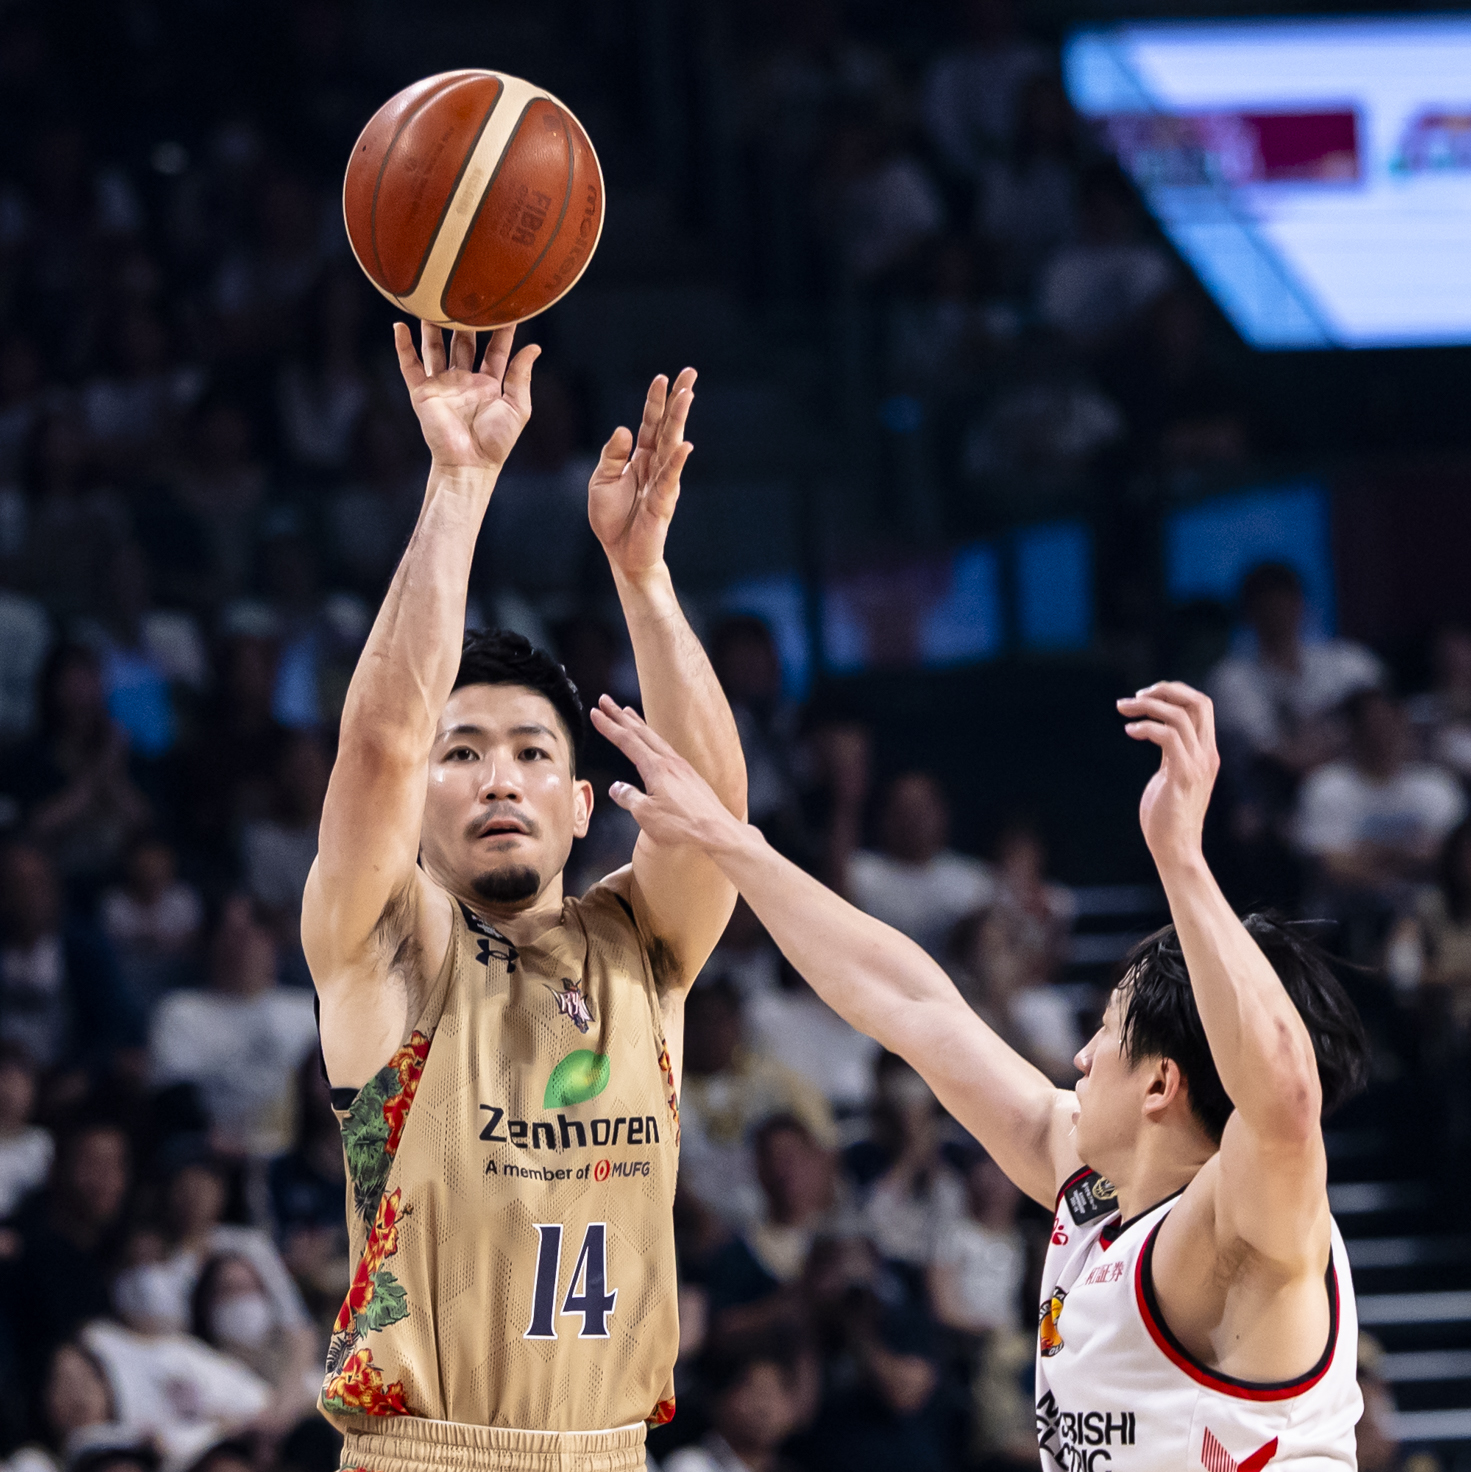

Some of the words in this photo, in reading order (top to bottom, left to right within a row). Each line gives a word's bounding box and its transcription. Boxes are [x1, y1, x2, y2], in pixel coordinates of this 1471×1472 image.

[512, 189, 552, 247] FIBA
[479, 1103, 660, 1150] Zenhoren
[485, 1160, 498, 1175] A
[503, 1163, 573, 1181] member
[576, 1163, 591, 1180] of
[611, 1161, 651, 1177] MUFG
[523, 1221, 619, 1340] 14
